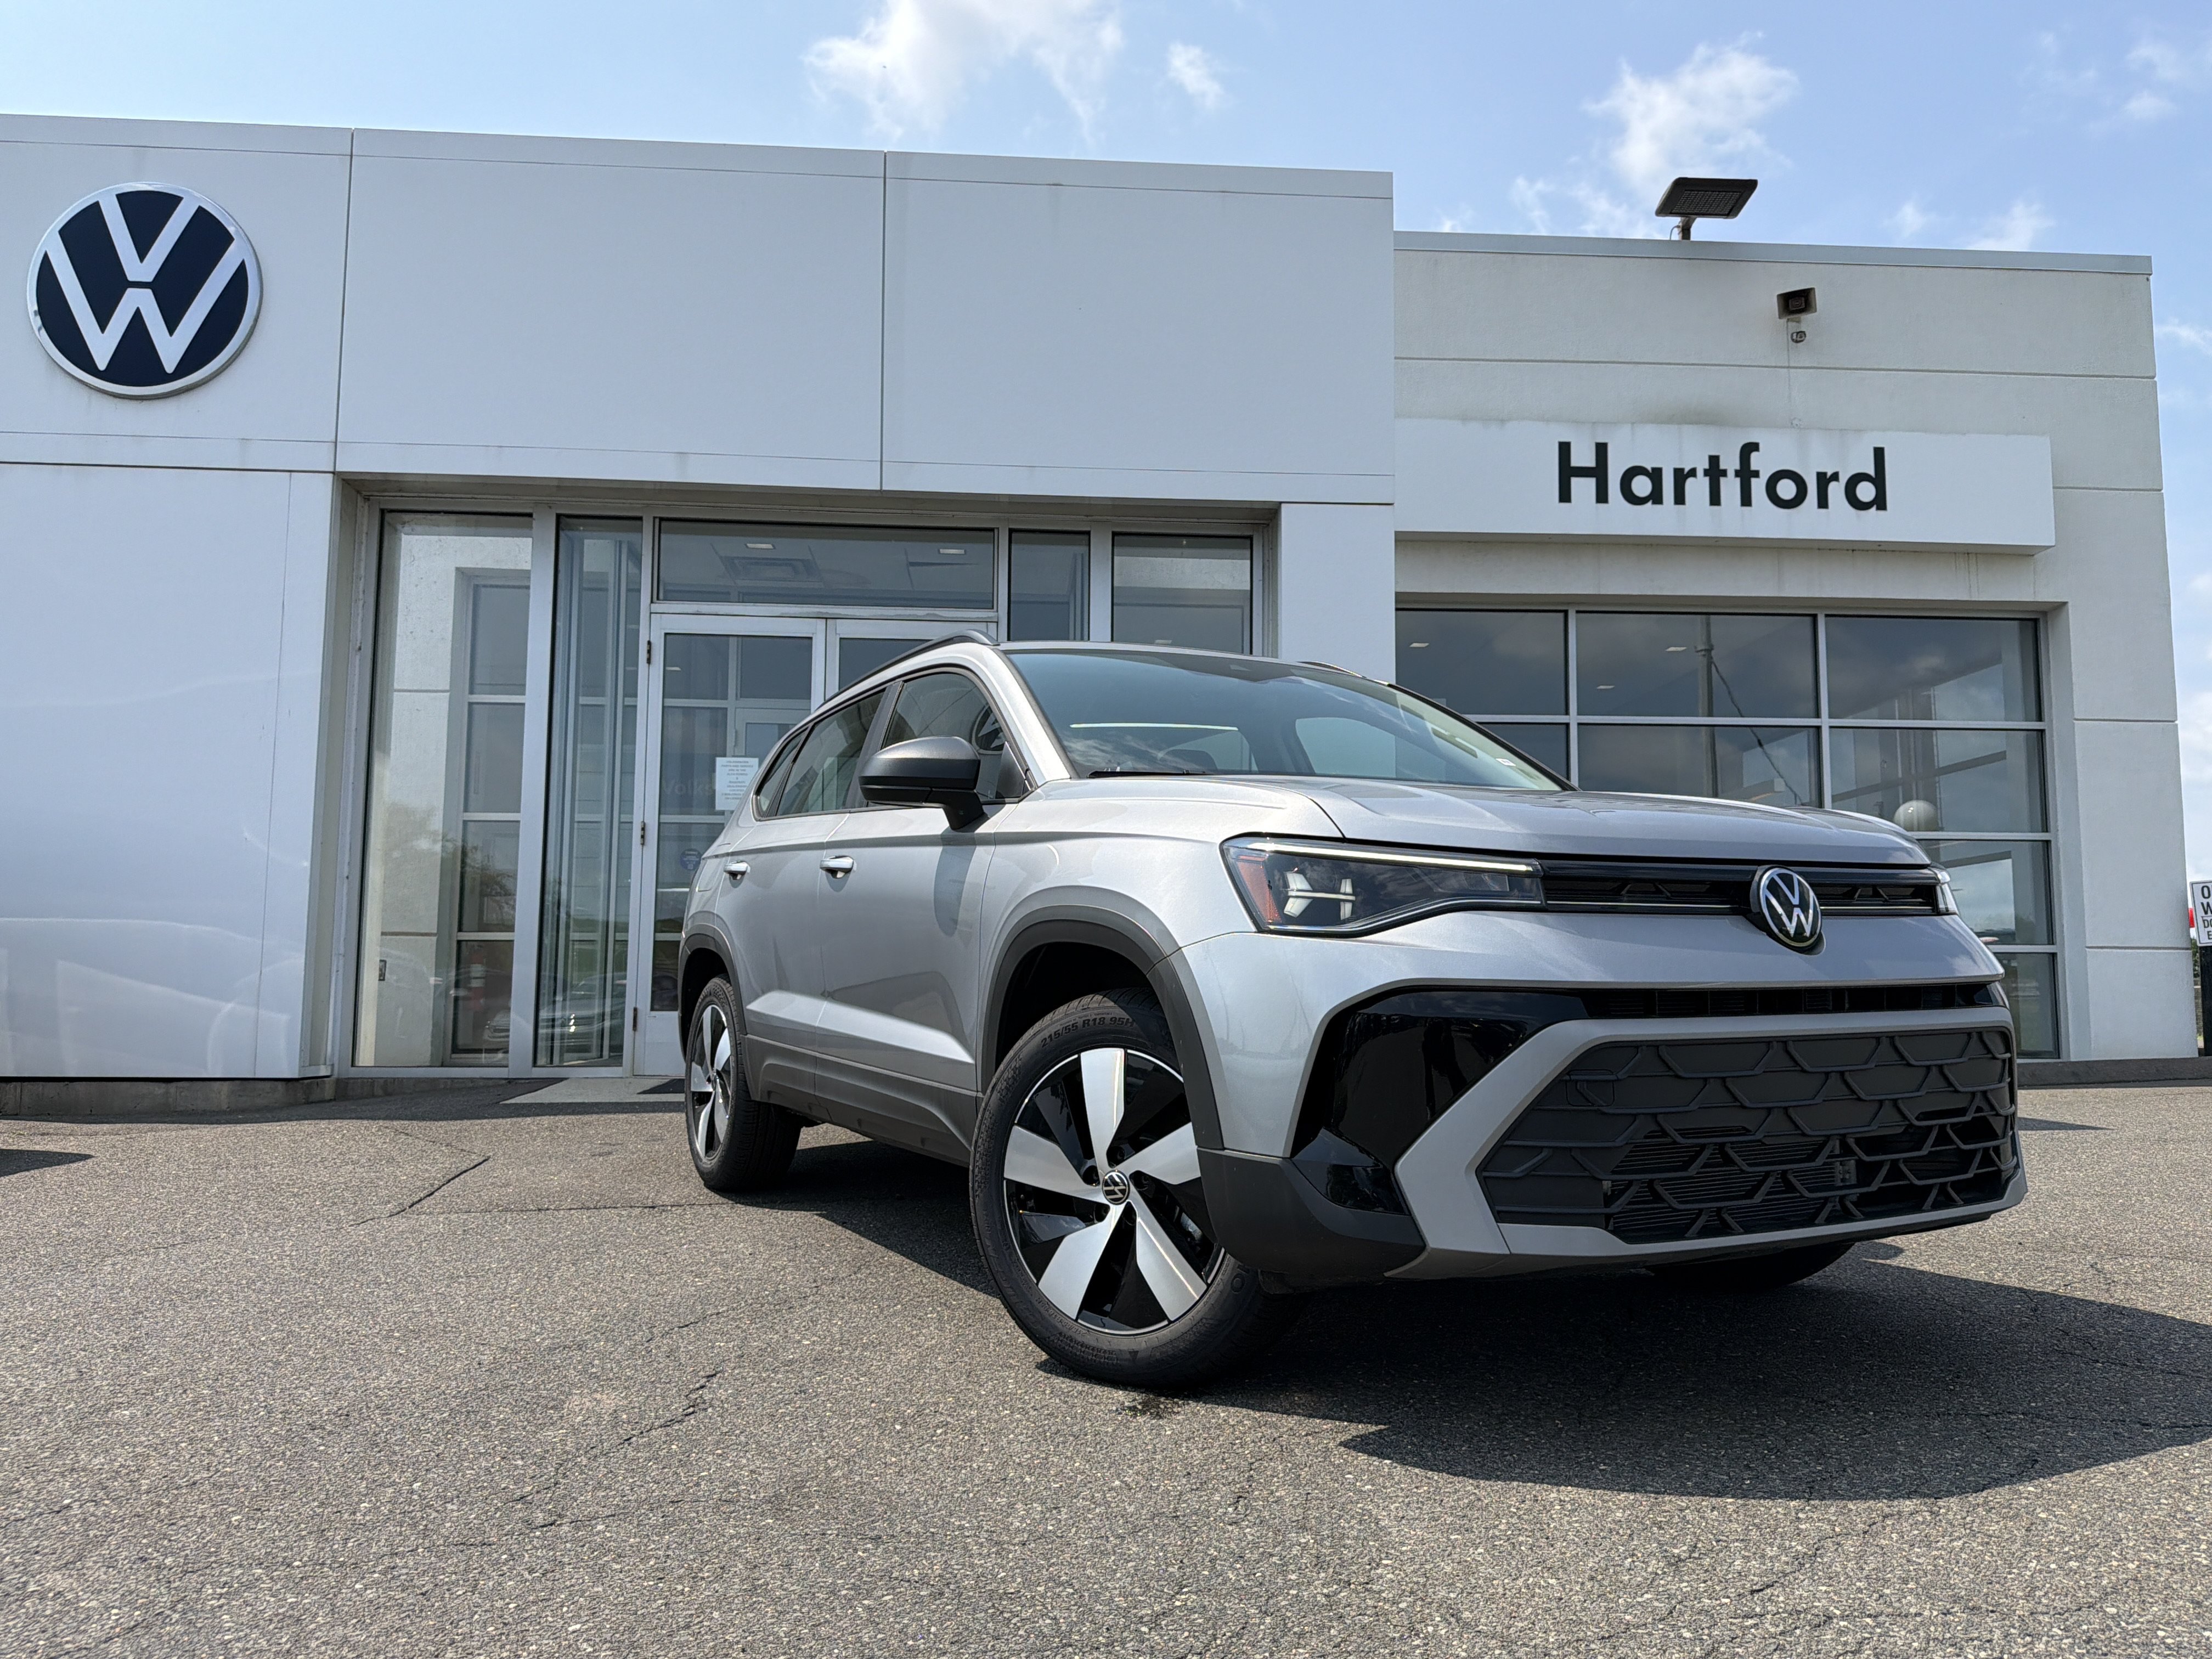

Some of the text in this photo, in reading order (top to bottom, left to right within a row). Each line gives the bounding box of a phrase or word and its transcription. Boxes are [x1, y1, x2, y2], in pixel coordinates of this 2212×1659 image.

[33, 189, 255, 379] VW
[1558, 441, 1887, 511] Hartford
[1761, 868, 1820, 941] VW
[2201, 885, 2212, 899] O
[1041, 1021, 1079, 1047] 215/55
[1082, 1017, 1106, 1029] R18
[1109, 1016, 1135, 1028] 95H
